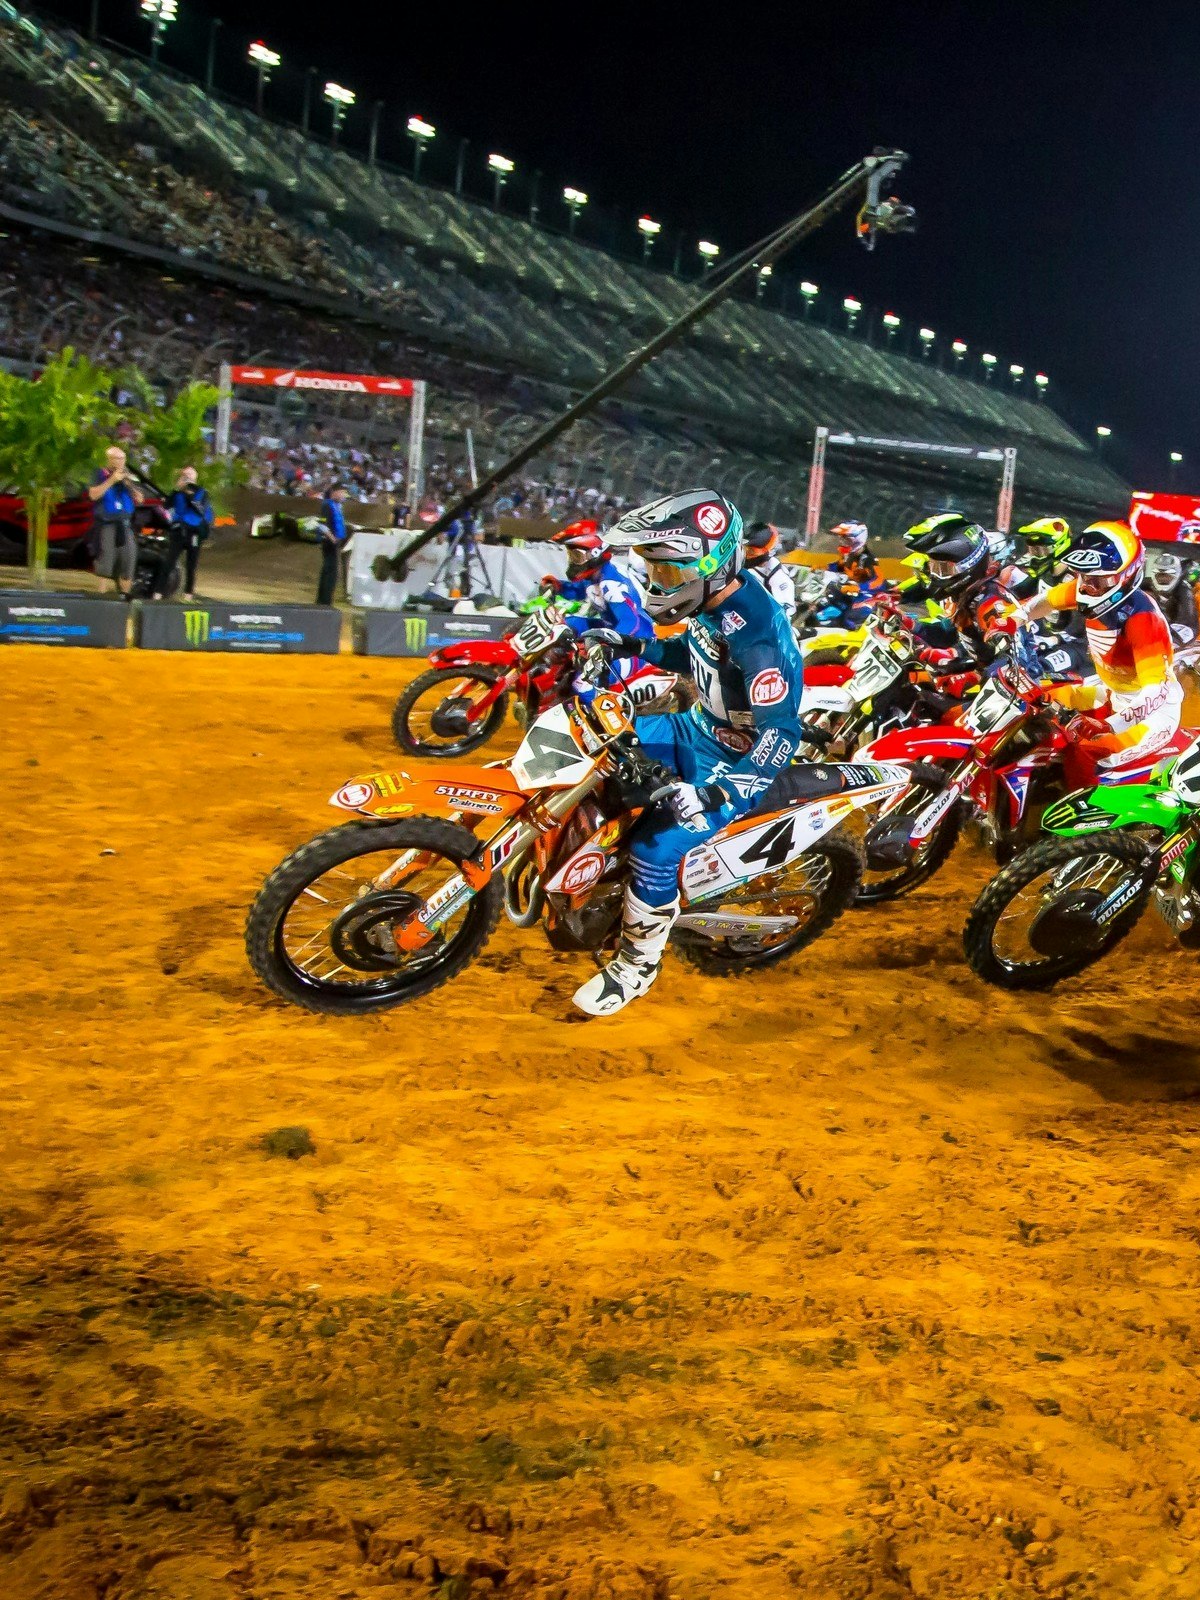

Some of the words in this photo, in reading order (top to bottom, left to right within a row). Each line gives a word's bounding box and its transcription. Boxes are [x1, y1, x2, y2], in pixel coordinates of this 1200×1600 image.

[869, 786, 896, 800] DUNLOP
[922, 793, 951, 829] DUNLOP
[739, 815, 797, 870] 4
[1096, 878, 1144, 925] DUNLOP
